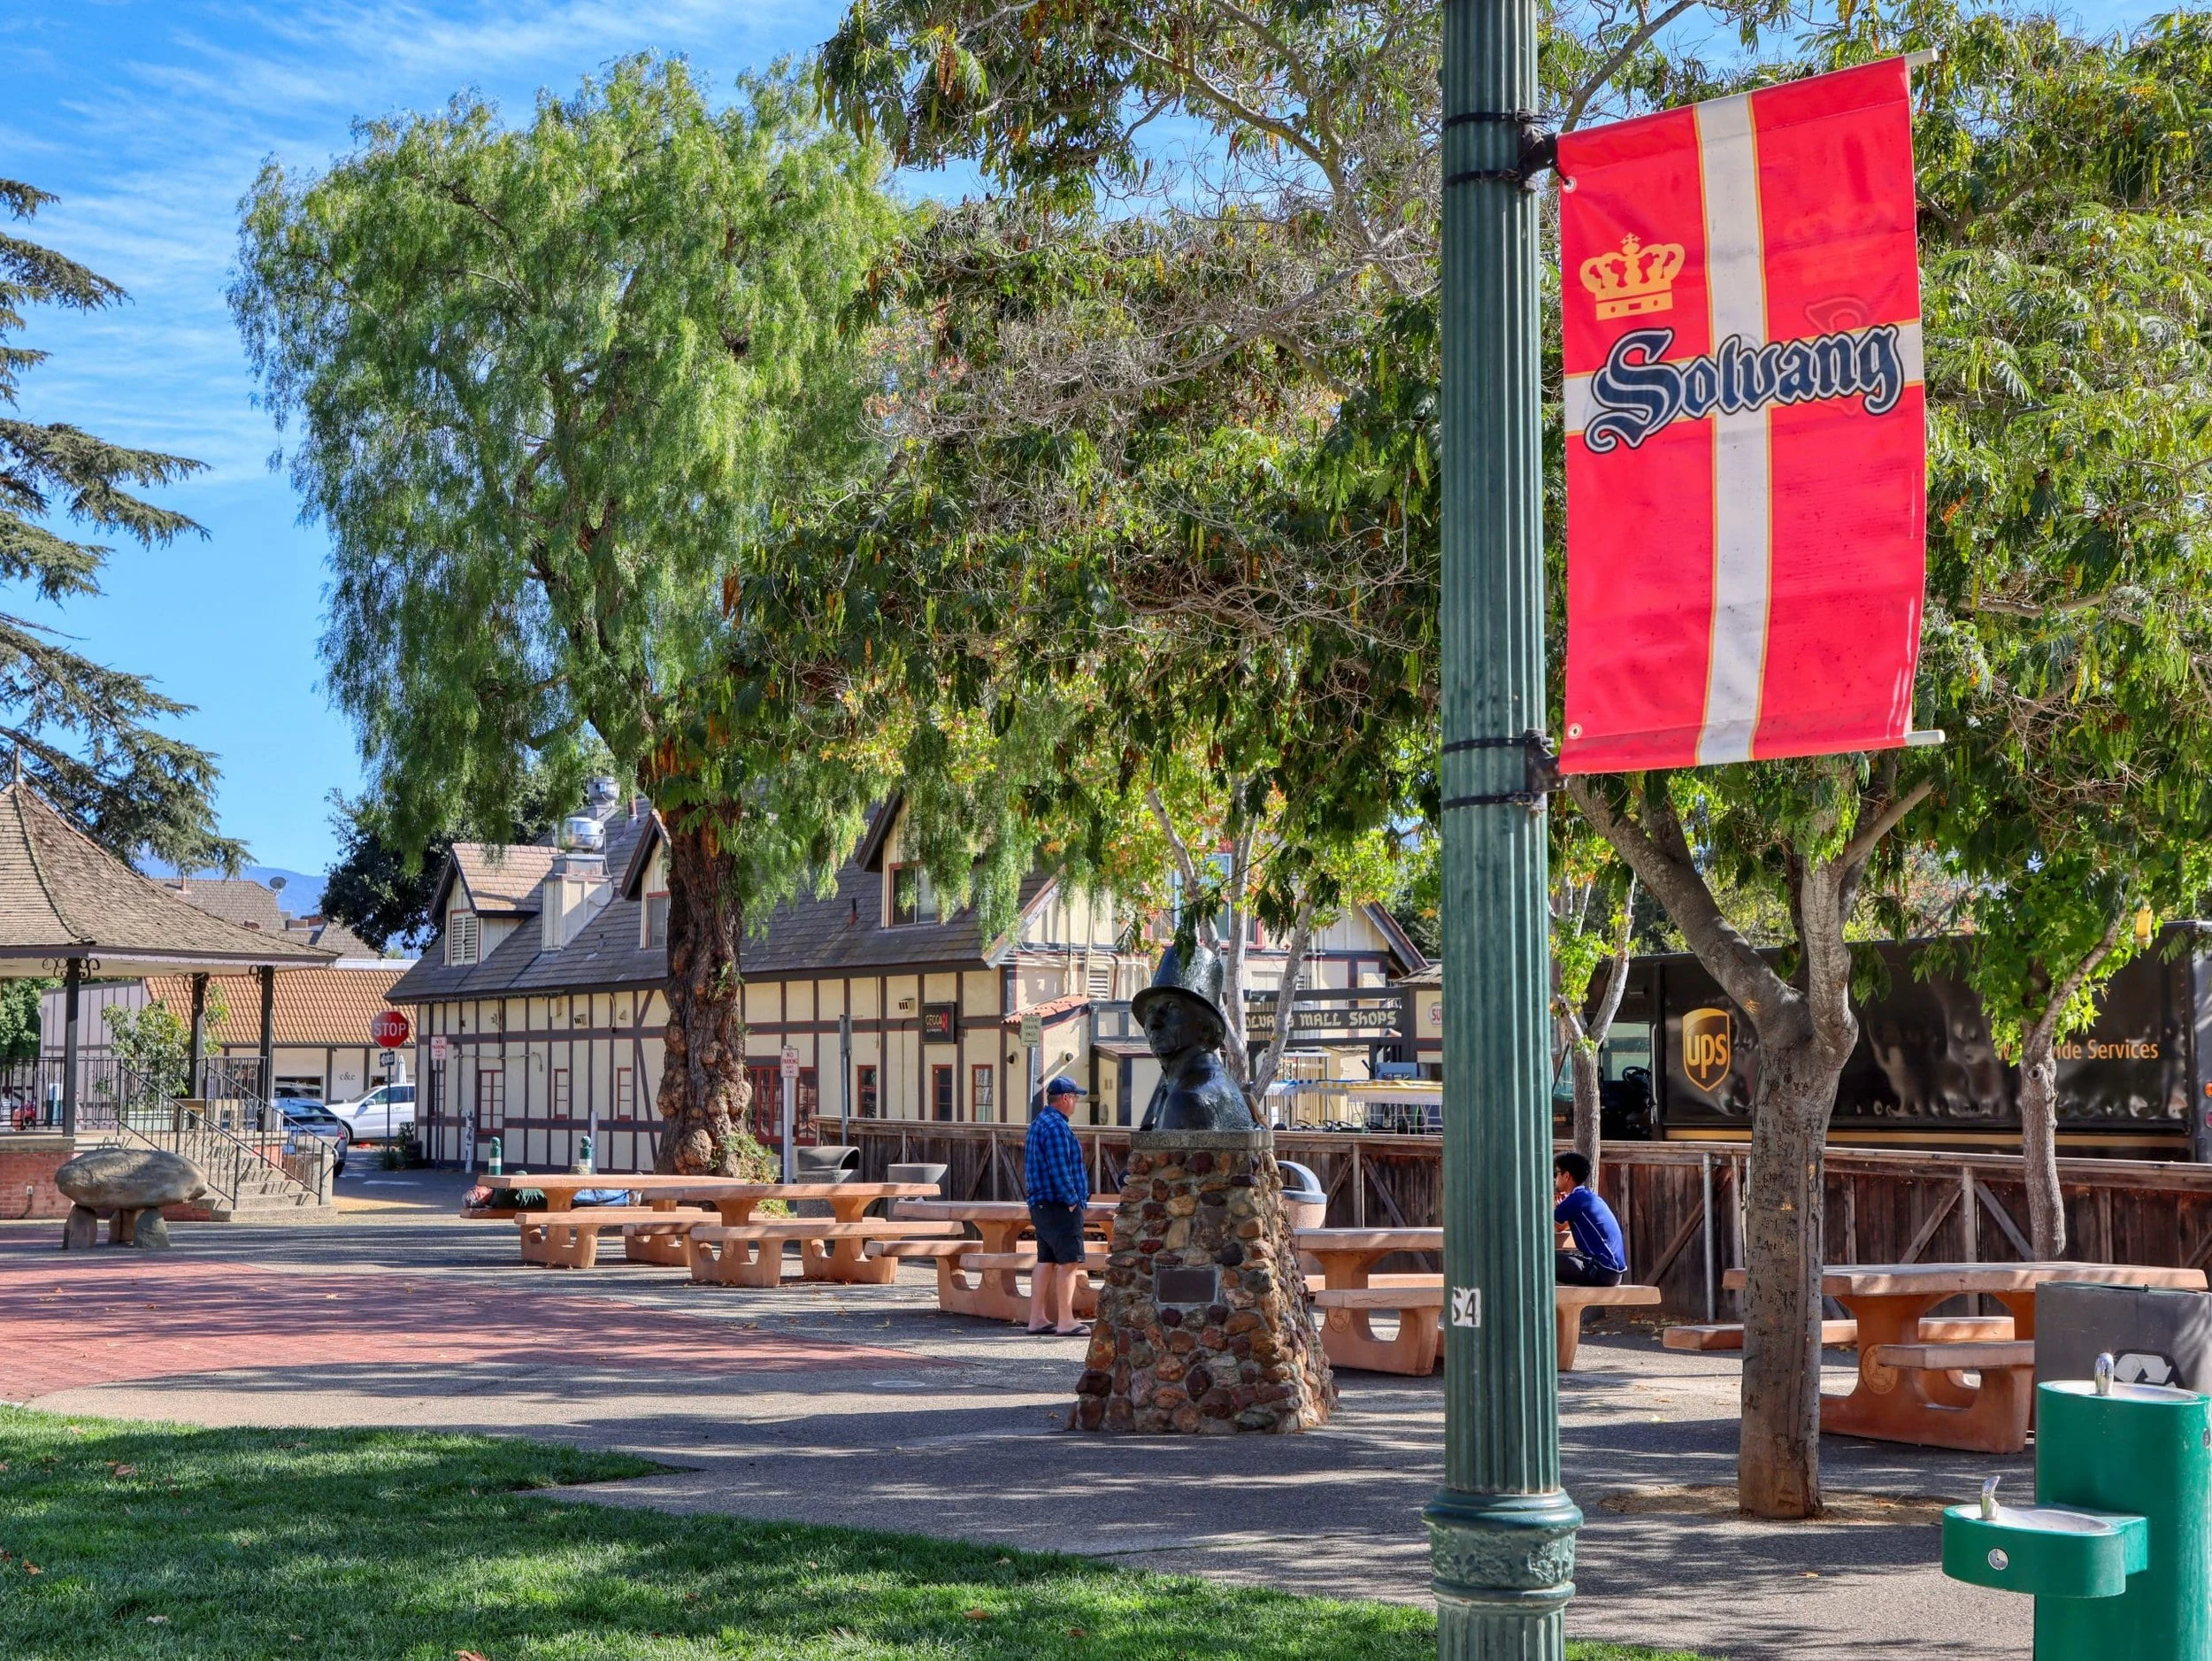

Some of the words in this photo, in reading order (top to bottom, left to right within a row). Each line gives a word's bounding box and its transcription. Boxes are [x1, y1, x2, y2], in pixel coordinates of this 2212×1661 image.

[1583, 324, 1905, 455] Solvang
[373, 1023, 406, 1036] STOP
[1300, 1012, 1341, 1027] MALL
[1686, 1034, 1728, 1079] ups
[2087, 1039, 2159, 1060] Services
